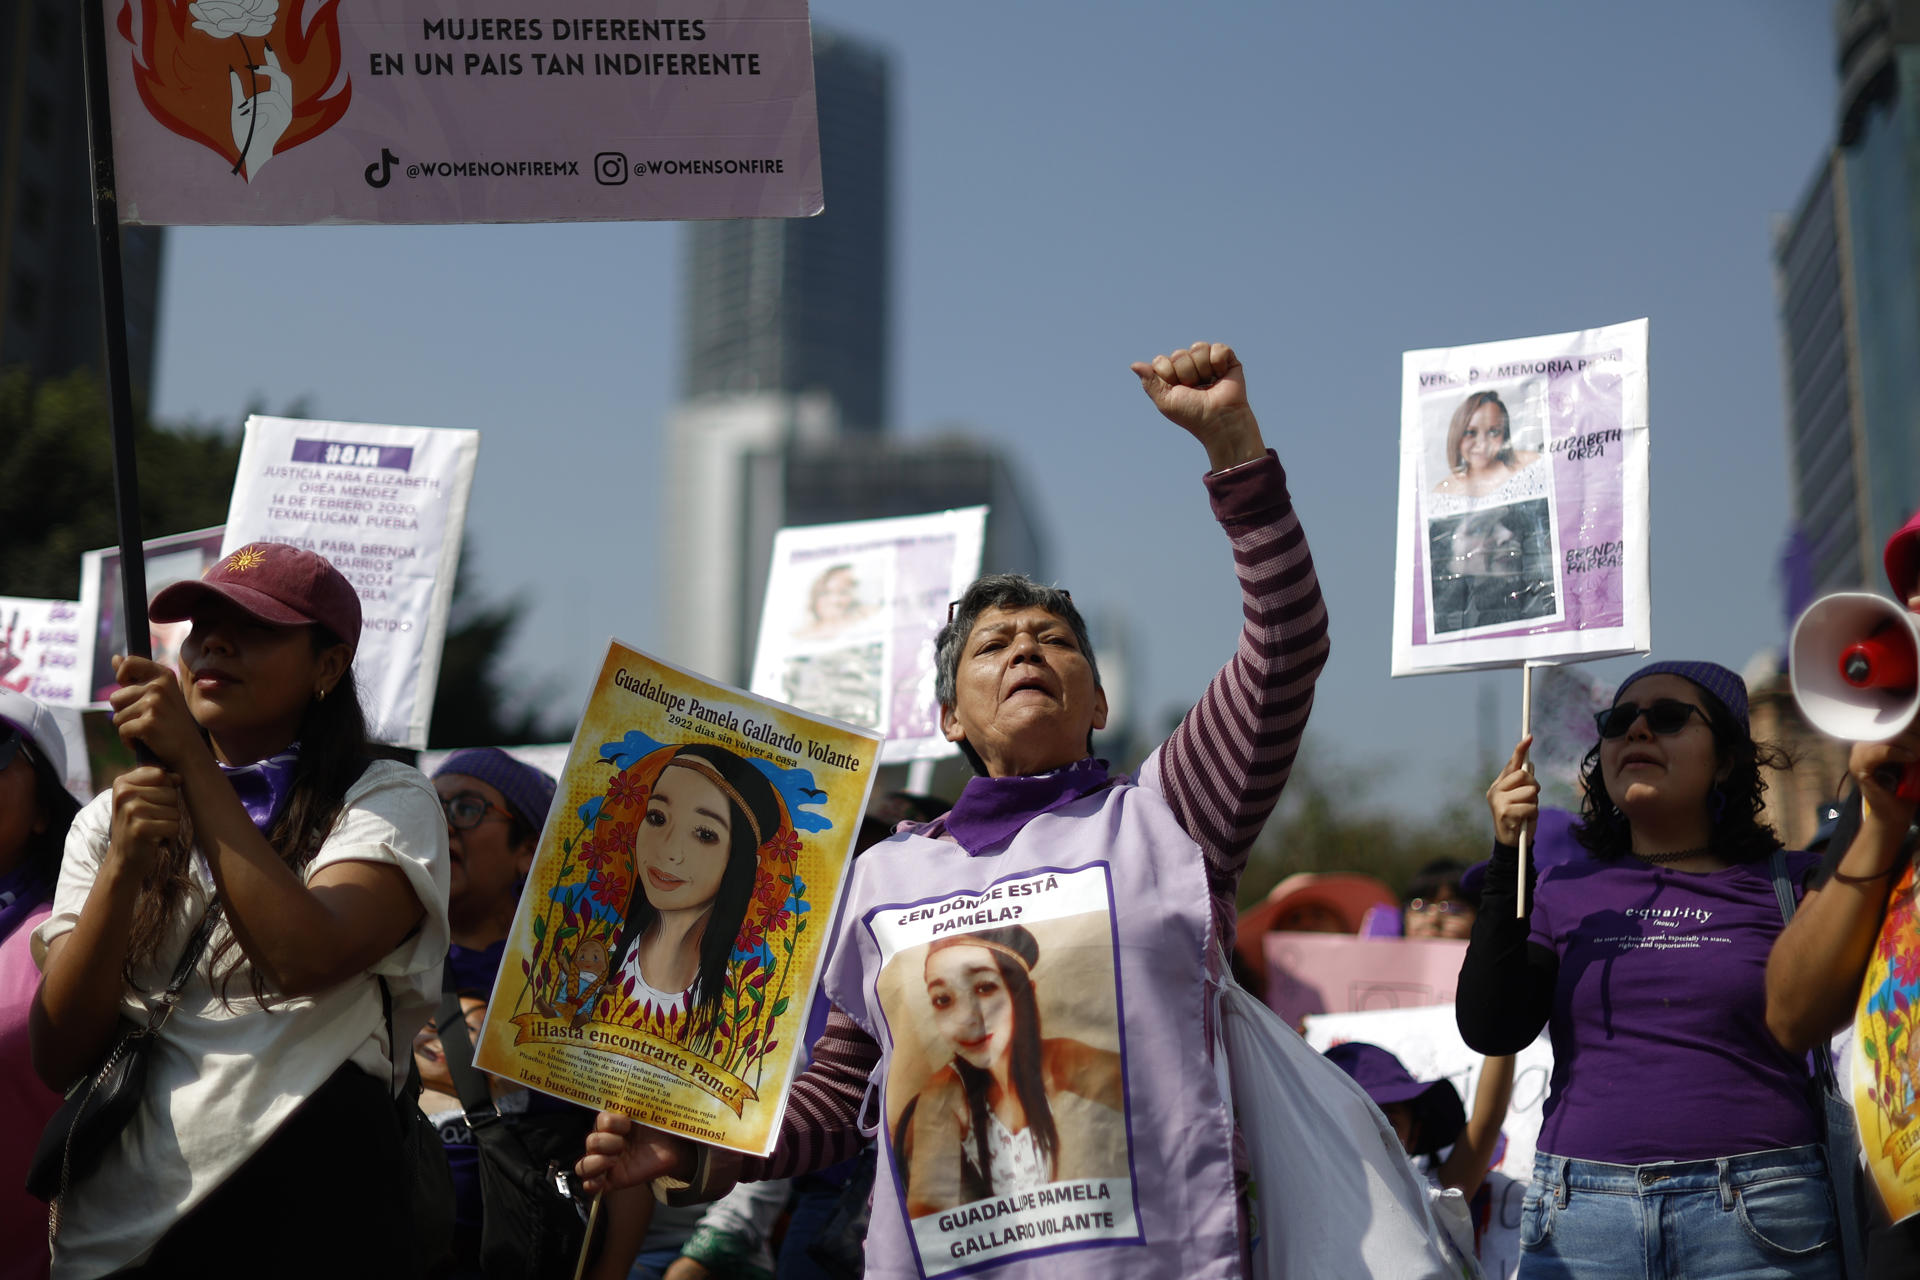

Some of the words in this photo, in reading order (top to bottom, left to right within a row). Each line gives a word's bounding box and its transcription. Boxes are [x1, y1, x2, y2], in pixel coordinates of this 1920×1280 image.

[423, 18, 543, 41] MUJERES
[552, 18, 706, 41] DIFERENTES
[369, 53, 404, 76] EN
[415, 53, 453, 76] UN
[464, 53, 523, 76] PAIS
[531, 53, 584, 76] TAN
[595, 53, 760, 76] INDIFERENTE
[406, 161, 579, 179] @WOMENONFIREMX
[633, 159, 784, 176] @WOMENSONFIRE
[1497, 359, 1573, 377] MEMORIA
[325, 444, 379, 467] #8M
[1568, 444, 1604, 461] OREA
[263, 465, 321, 482] JUSTICIA
[326, 470, 364, 484] PARA
[366, 473, 440, 489] ELIZABETH
[272, 494, 286, 505] 14
[289, 496, 308, 508] DE
[310, 497, 374, 513] FEBRERO
[366, 516, 419, 531] PUEBLA
[320, 540, 356, 554] PARA
[360, 544, 416, 559] BRENDA
[1566, 541, 1623, 561] BRENDA
[333, 557, 393, 572] BARRIOS
[356, 572, 393, 586] 2024
[356, 586, 388, 601] EBLA
[615, 668, 686, 713] Guadalupe
[687, 698, 739, 732] Pamela
[742, 719, 803, 754] Gallardo
[807, 739, 860, 772] Volante
[668, 713, 692, 730] 2922
[717, 731, 733, 746] sin
[734, 737, 766, 757] volver
[766, 751, 774, 760] a
[775, 753, 798, 768] casa
[898, 907, 934, 926] ¿EN
[939, 887, 1003, 916] DÓNDE
[1008, 875, 1059, 898] ESTÁ
[931, 905, 1023, 935] PAMELA?
[1653, 919, 1680, 928] (noun)
[1668, 935, 1700, 943] especially
[531, 1021, 584, 1041] ¡Hasta
[589, 1029, 688, 1071] encontrarte
[689, 1063, 739, 1102] Pame!
[520, 1068, 541, 1085] ¡Les
[545, 1075, 602, 1104] buscamos
[604, 1100, 648, 1119] porque
[651, 1111, 668, 1125] les
[670, 1119, 726, 1141] amamos!
[1039, 1183, 1111, 1208] PAMELA
[1037, 1212, 1114, 1239] VOLANTE
